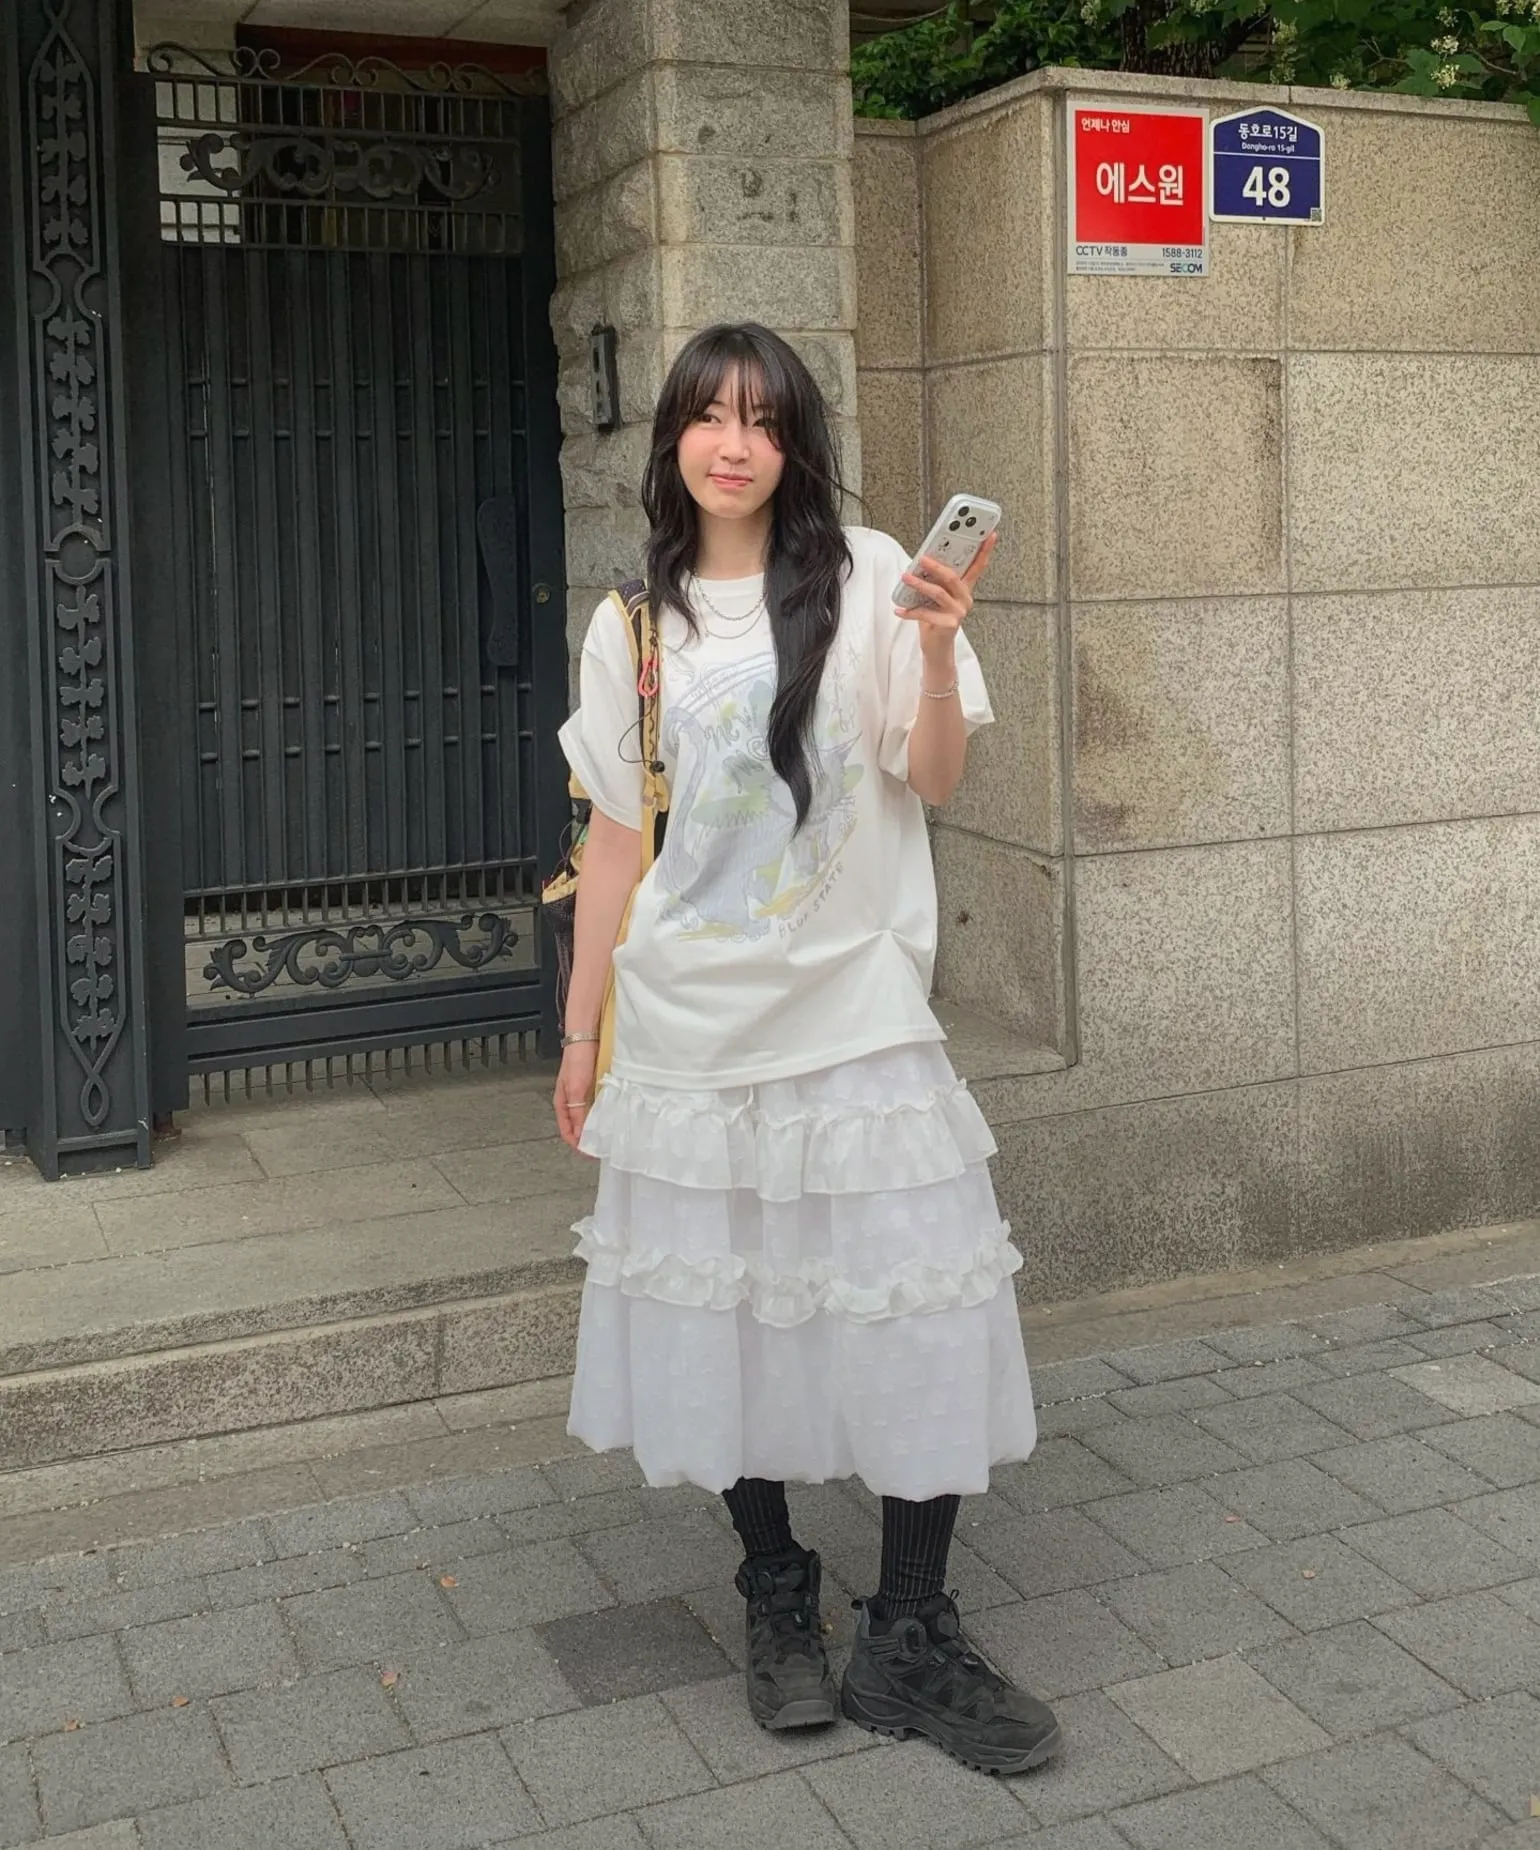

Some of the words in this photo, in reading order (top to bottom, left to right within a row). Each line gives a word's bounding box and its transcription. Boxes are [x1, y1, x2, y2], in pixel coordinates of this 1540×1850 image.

[1081, 118, 1110, 133] 언제나
[1112, 119, 1130, 134] 안심
[1238, 123, 1298, 142] 동호로15길
[1242, 142, 1276, 153] Dongho-ro
[1277, 144, 1295, 153] 15-gil
[1096, 162, 1184, 206] 에스원
[1242, 166, 1290, 208] 48
[1076, 246, 1103, 257] CCTV
[1104, 246, 1128, 257] 작동중
[1162, 248, 1203, 259] 1588-3112
[1170, 262, 1203, 273] SECOM
